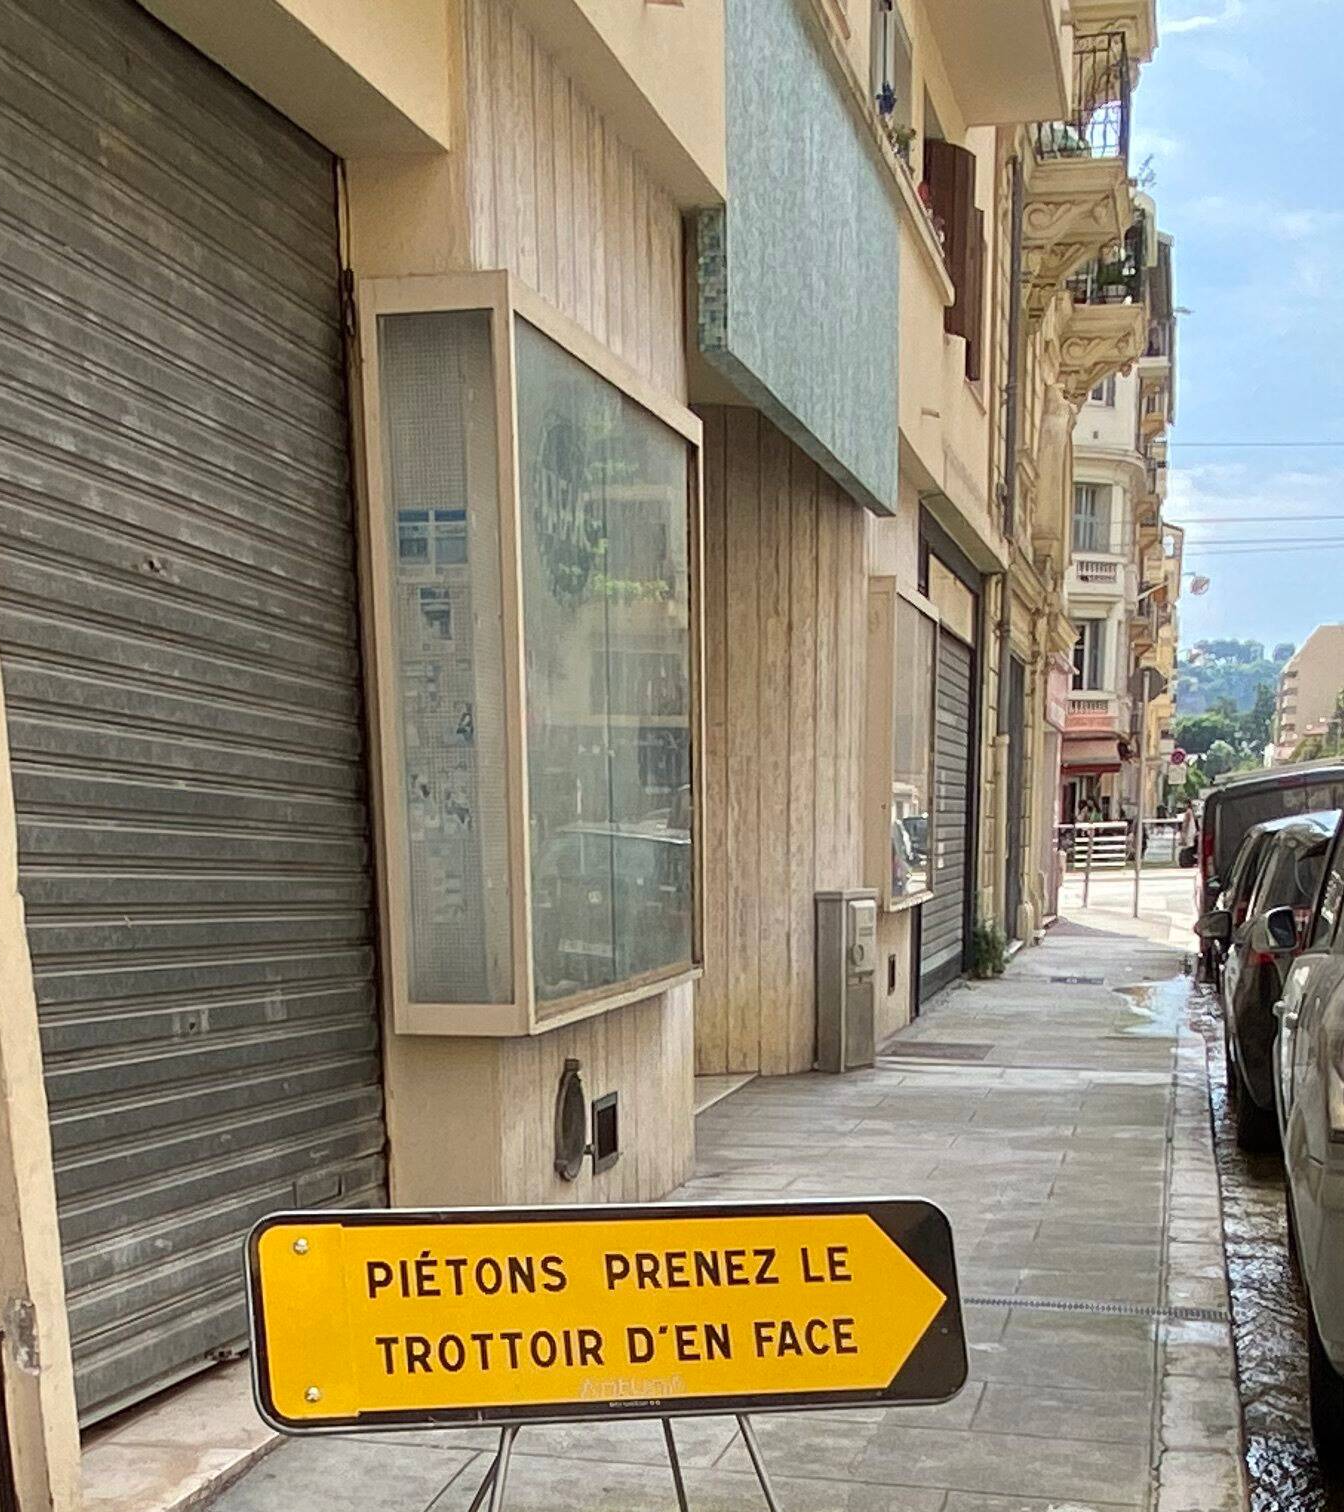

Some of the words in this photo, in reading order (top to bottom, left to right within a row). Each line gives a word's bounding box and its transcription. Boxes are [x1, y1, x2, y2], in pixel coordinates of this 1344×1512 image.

[366, 1250, 567, 1299] PIÉTONS
[604, 1248, 780, 1291] PRENEZ
[800, 1246, 852, 1283] LE
[375, 1329, 605, 1375] TROTTOIR
[626, 1323, 732, 1364] D'EN
[753, 1318, 858, 1358] FACE
